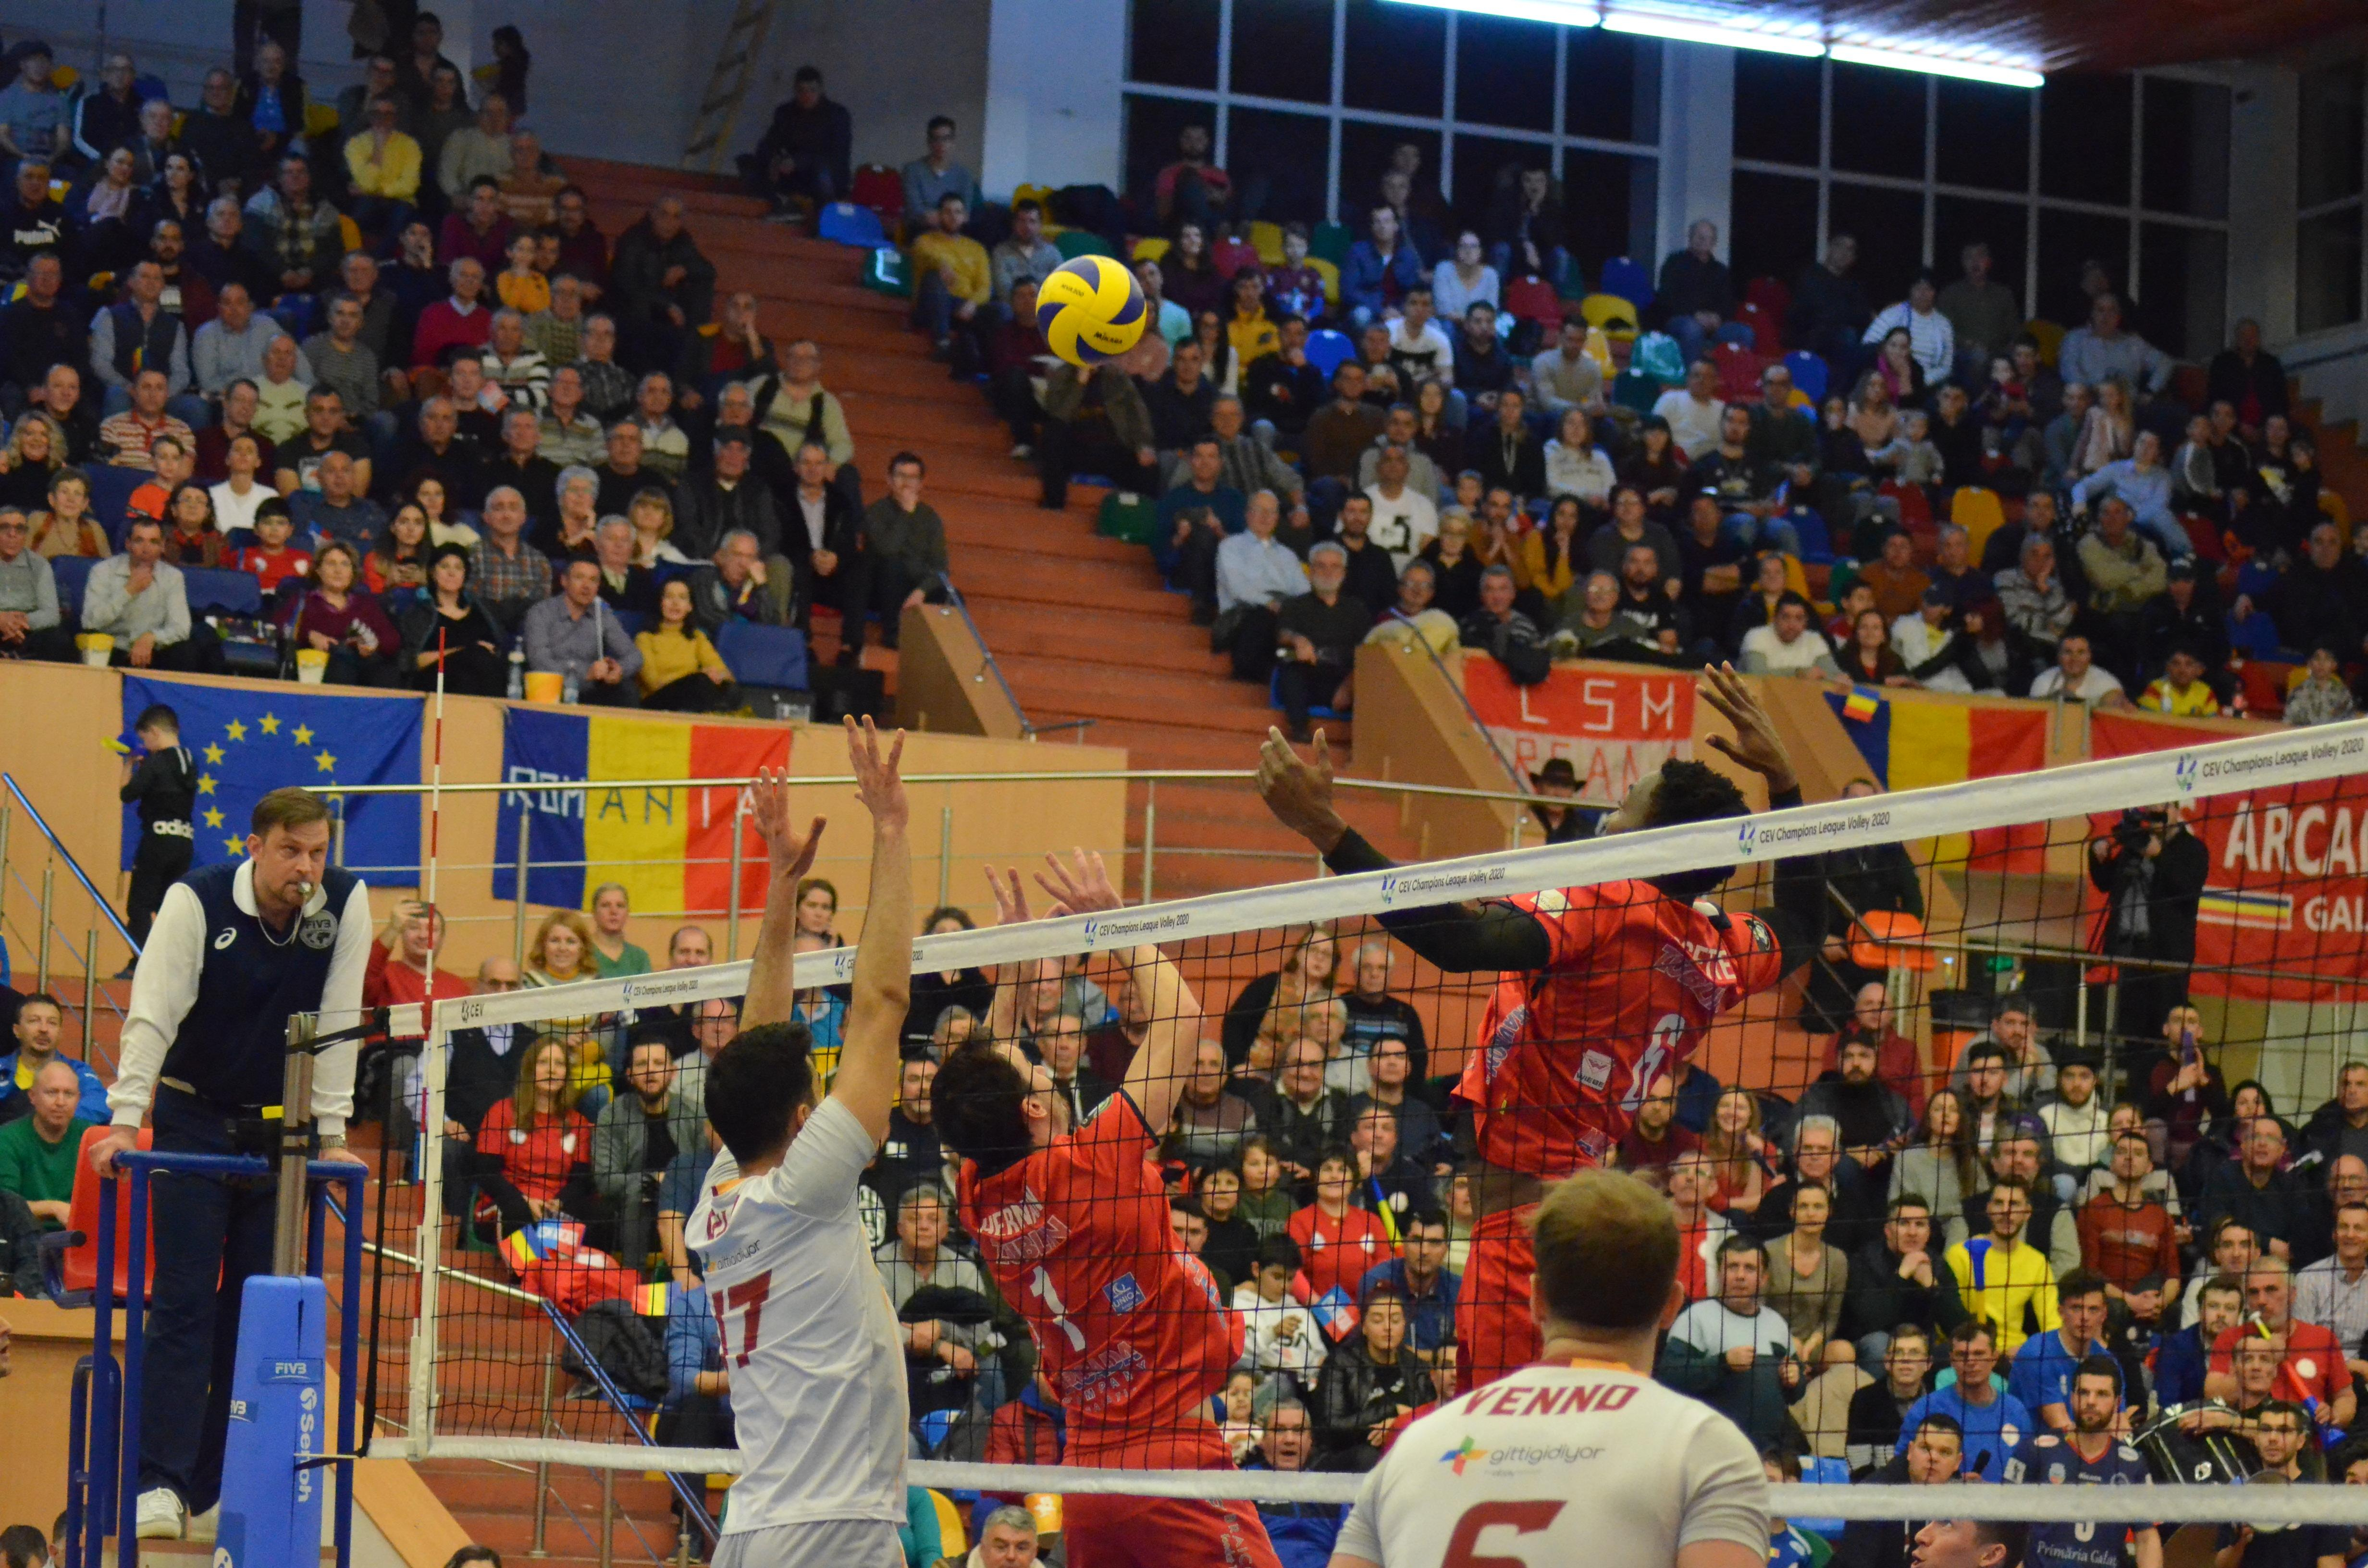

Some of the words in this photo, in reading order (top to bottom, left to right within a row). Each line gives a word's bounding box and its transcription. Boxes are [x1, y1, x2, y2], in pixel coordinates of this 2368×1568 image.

[2203, 761, 2221, 777] CEV
[2223, 754, 2273, 774] Champions
[2275, 749, 2308, 767] League
[2310, 742, 2340, 760] Volley
[2341, 736, 2364, 755] 2020
[1760, 829, 1775, 843] CEV
[1776, 823, 1817, 841] Champions
[1818, 820, 1845, 836] League
[1848, 815, 1870, 831] Volley
[1871, 811, 1890, 826] 2020
[2223, 798, 2368, 877] ARCA
[1398, 880, 1412, 894] CEV
[1412, 876, 1444, 892] Champions
[1445, 874, 1467, 887] League
[1468, 870, 1488, 883] Volley
[1489, 867, 1505, 880] 2020
[1099, 925, 1110, 936] CEV
[1110, 921, 1139, 936] Champions
[1139, 920, 1159, 932] League
[1159, 915, 1175, 930] Volley
[1176, 913, 1189, 926] 2020
[1576, 1072, 1604, 1088] WIEBE
[275, 1362, 307, 1374] FIVB
[1462, 1384, 1640, 1416] VENNO
[298, 1413, 314, 1503] Senoh
[1489, 1443, 1606, 1466] gittigidiyor
[1224, 1514, 1253, 1568] BRAIC
